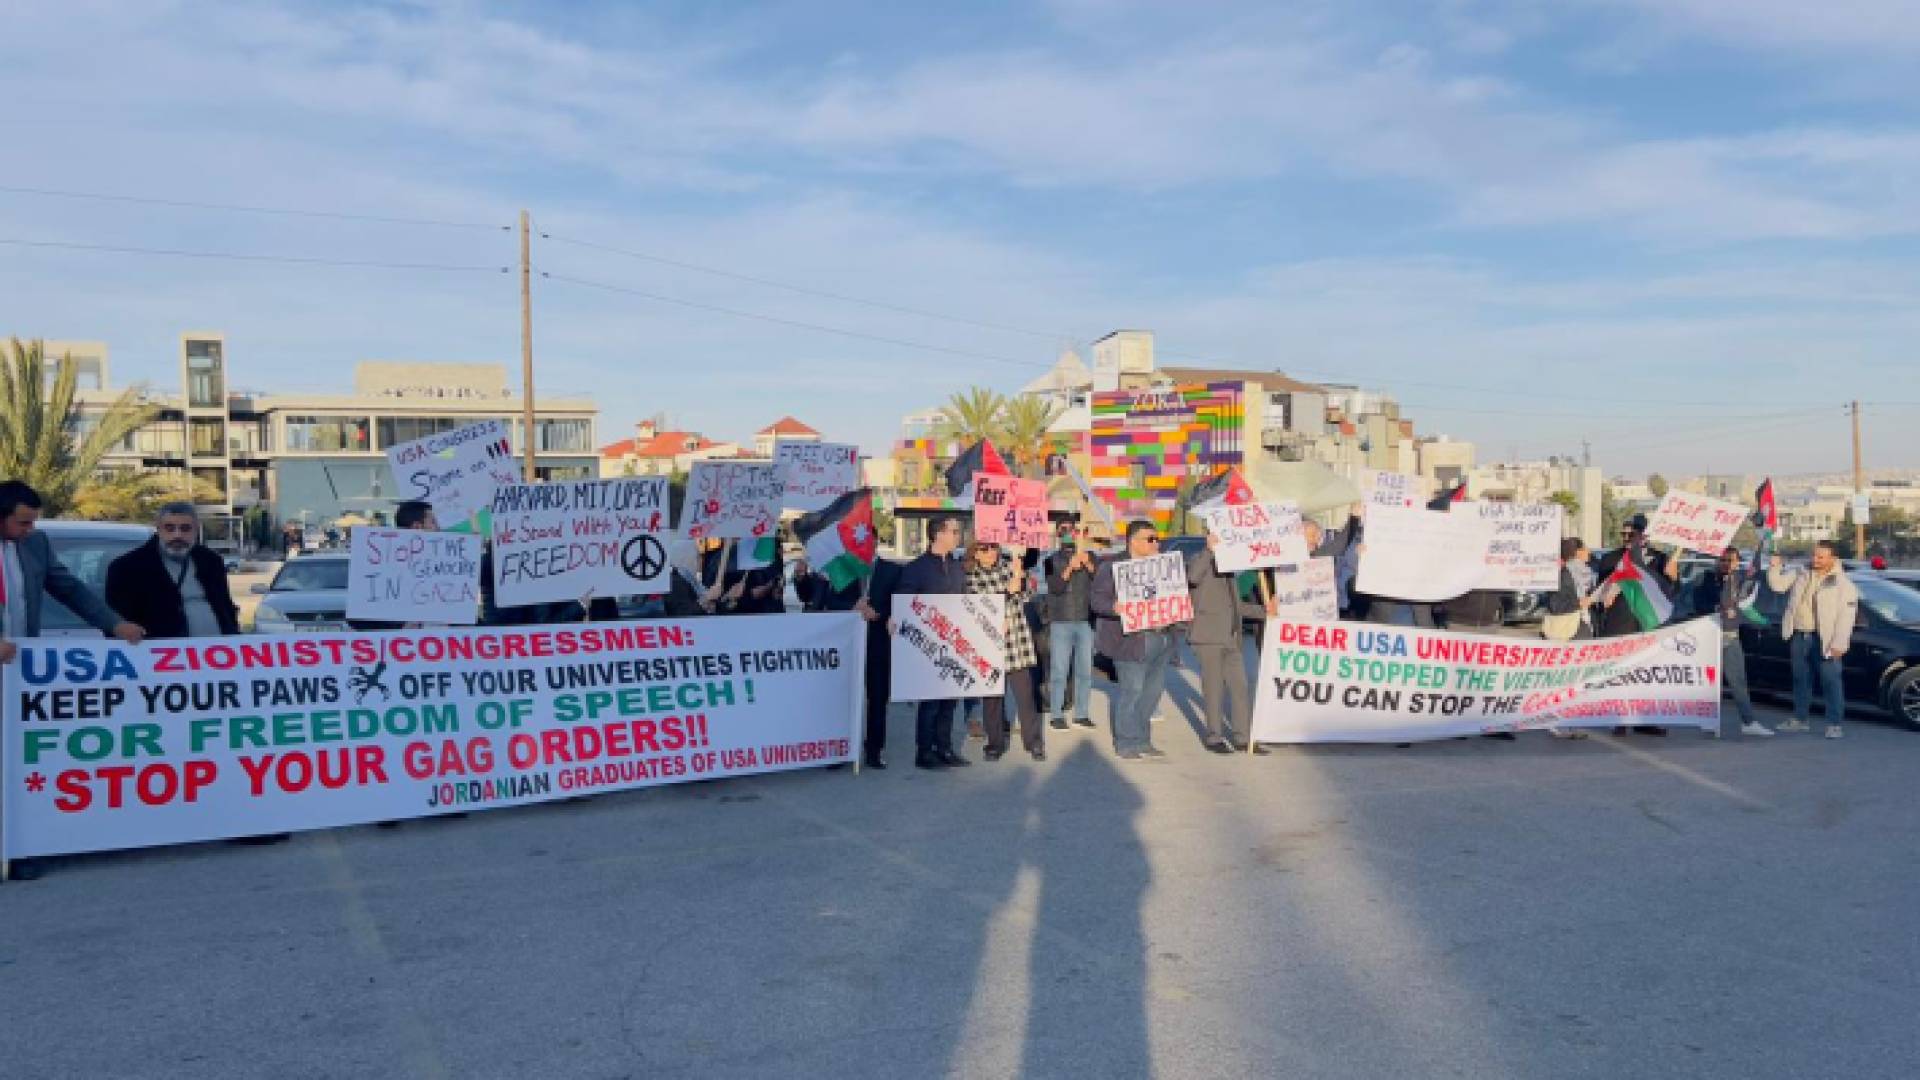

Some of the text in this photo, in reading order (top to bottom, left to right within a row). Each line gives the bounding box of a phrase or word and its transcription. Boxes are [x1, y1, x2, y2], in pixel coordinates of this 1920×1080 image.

[396, 443, 427, 464] USA
[500, 539, 621, 586] FREEDOM
[1280, 622, 1348, 651] DEAR
[1357, 631, 1408, 657] USA
[21, 647, 138, 684] USA
[21, 647, 841, 721] KEEP YOUR PAWS OFF YOUR UNIVERSITIES FIGHTING
[1278, 647, 1332, 676] YOU
[1337, 656, 1449, 690] STOPPED
[1455, 667, 1499, 692] THE
[1272, 677, 1334, 705] YOU
[1342, 685, 1402, 711] CAN
[1409, 694, 1475, 716] STOP
[1482, 695, 1524, 717] THE
[23, 722, 166, 764] FOR
[189, 703, 460, 753] FREEDOM
[475, 699, 535, 731] OF
[552, 680, 736, 722] SPEECH
[239, 745, 389, 796] YOUR
[402, 736, 495, 781] GAG
[507, 714, 709, 770] ORDERS!!
[428, 772, 551, 808] JORDANIAN
[558, 758, 687, 790] GRADUATES
[692, 752, 718, 773] OF
[722, 747, 758, 770] USA
